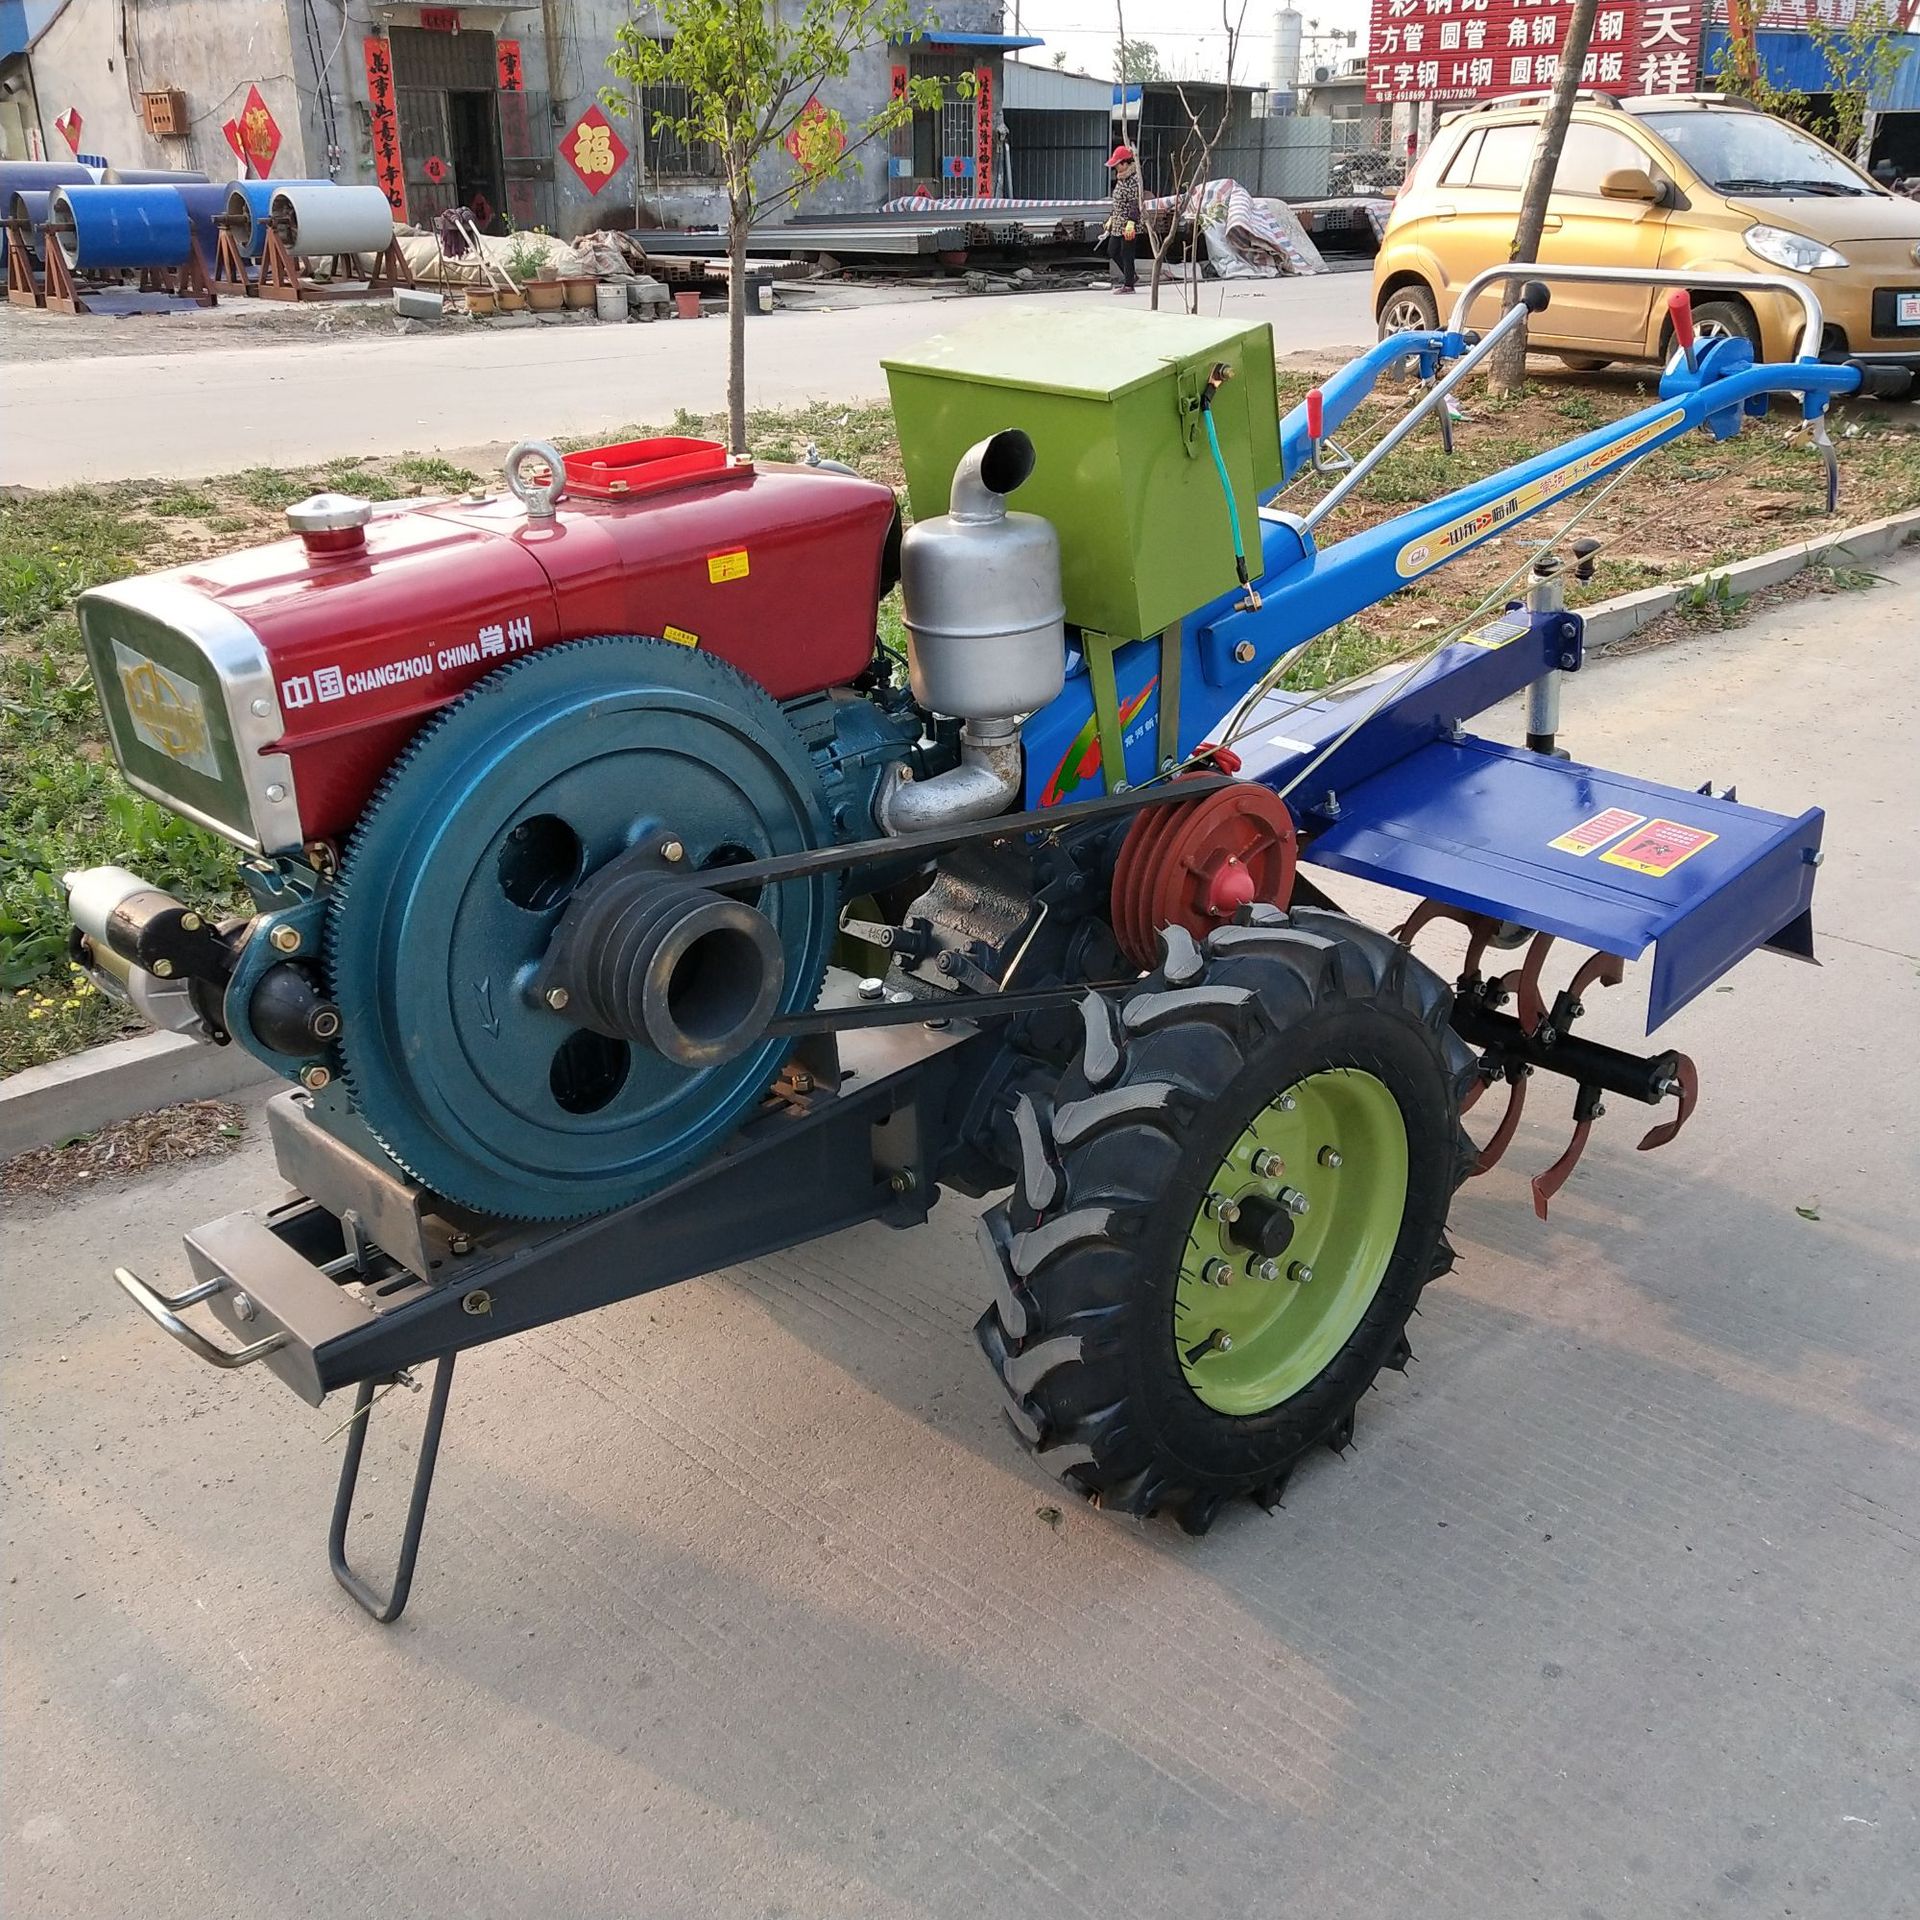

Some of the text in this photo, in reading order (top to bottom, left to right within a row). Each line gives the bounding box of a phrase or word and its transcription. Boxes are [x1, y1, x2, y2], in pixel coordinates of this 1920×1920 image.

[1380, 10, 1624, 54] 方管 圆管 角钢 钢
[1370, 60, 1439, 90] 工字钢
[1452, 57, 1493, 87] H钢
[1510, 54, 1560, 85] 圆钢
[574, 122, 615, 174] 福
[282, 616, 533, 710] 中国 CHANGZHOU CHINA 常州
